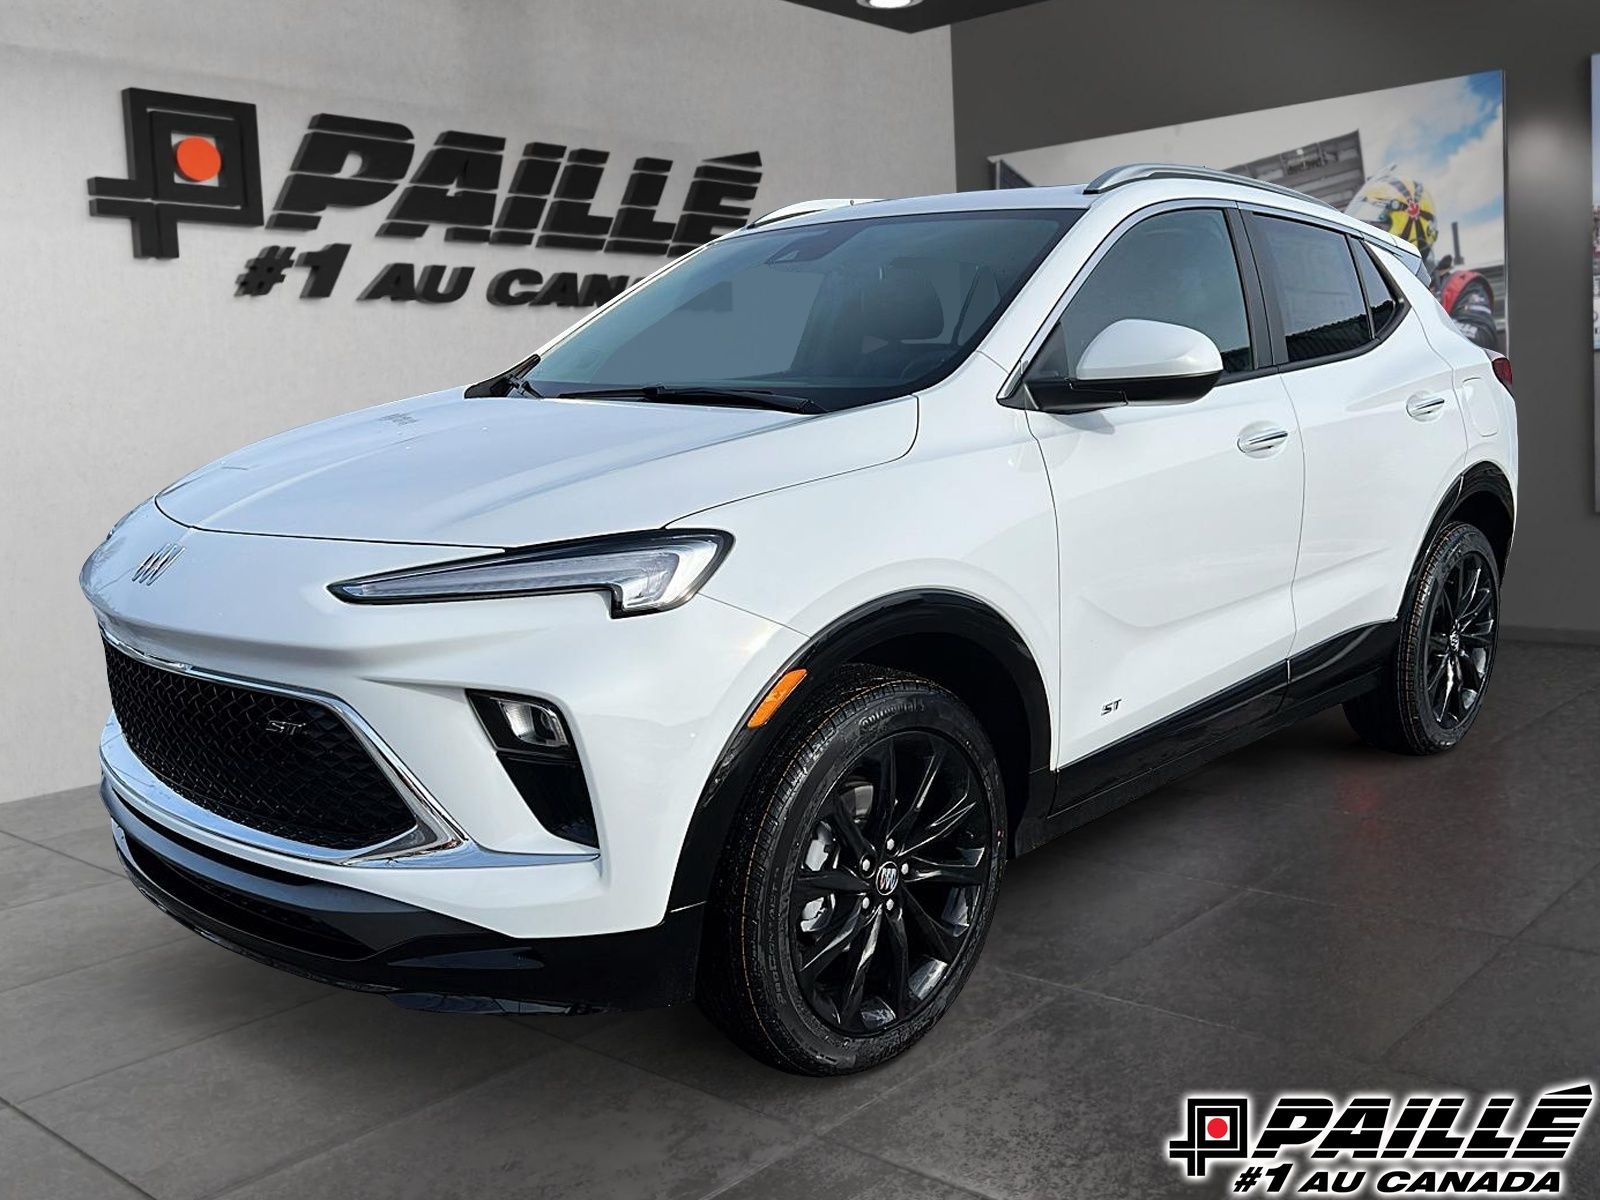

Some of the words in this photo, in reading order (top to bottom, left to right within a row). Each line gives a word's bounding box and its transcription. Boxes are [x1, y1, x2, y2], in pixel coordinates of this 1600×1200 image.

[265, 113, 763, 258] PAILLÉ
[234, 243, 352, 299] #1
[355, 262, 476, 303] AU
[486, 268, 650, 307] CAN
[265, 719, 307, 736] ST
[1100, 698, 1122, 716] ST
